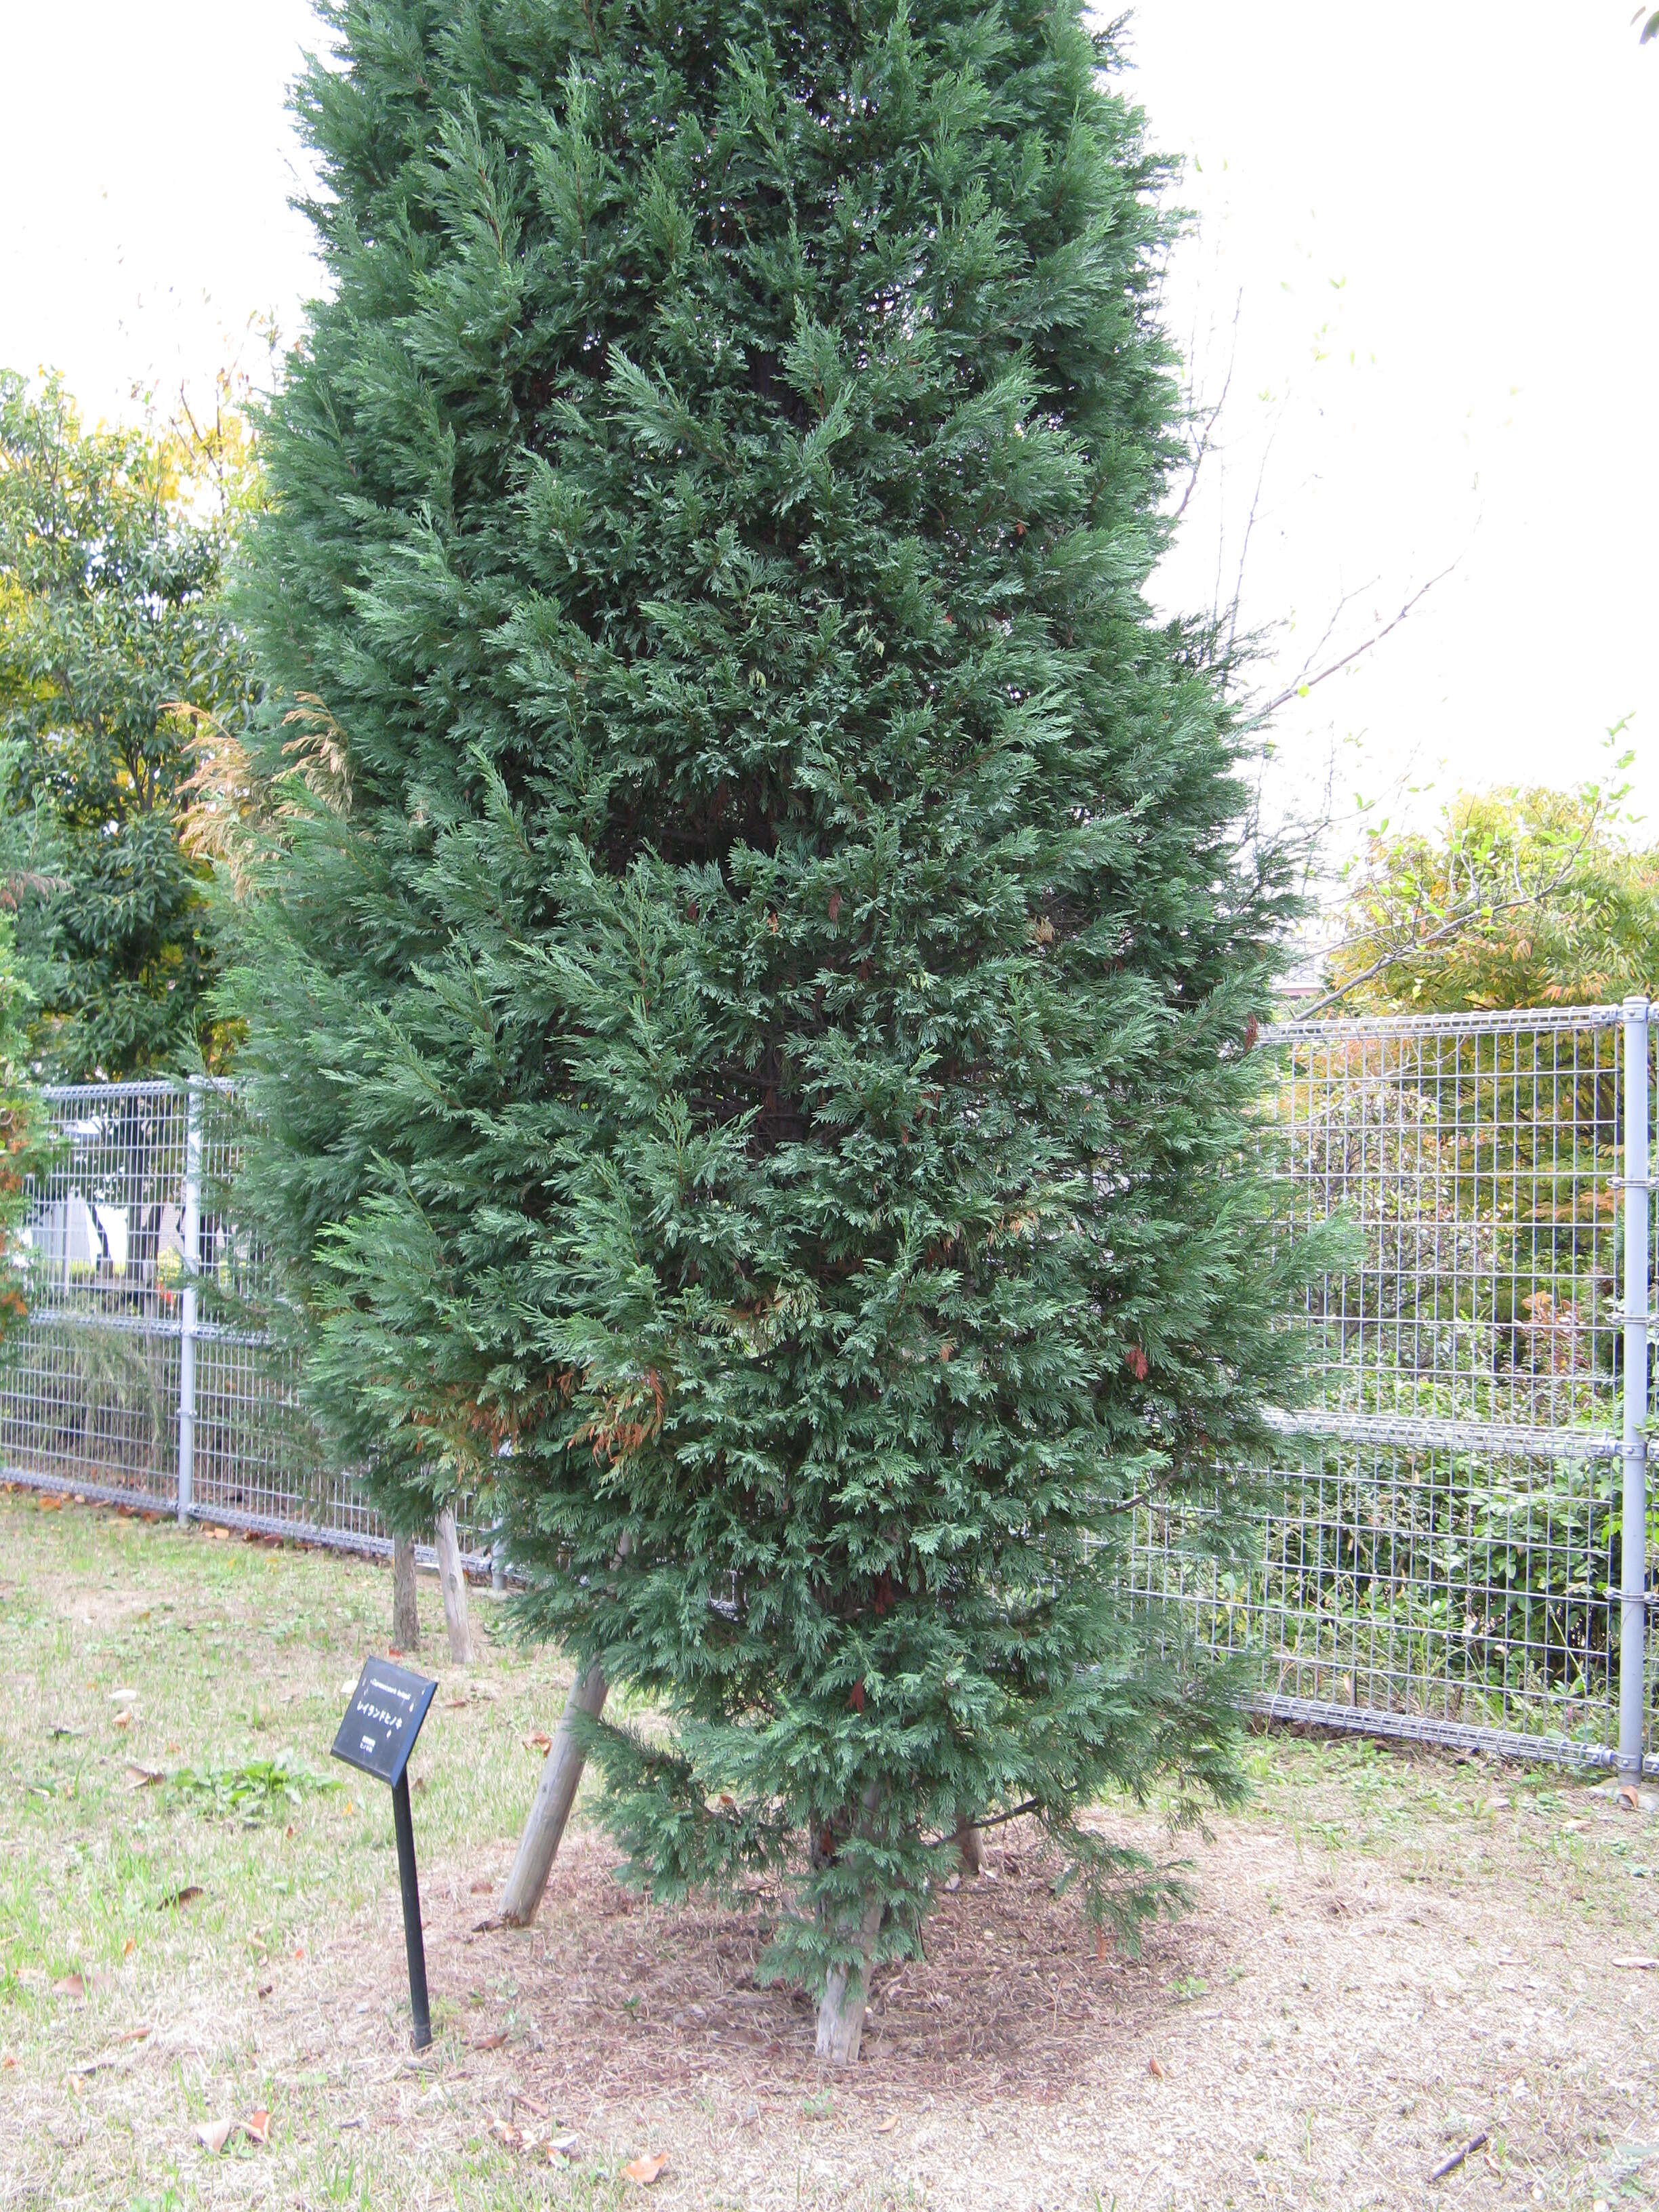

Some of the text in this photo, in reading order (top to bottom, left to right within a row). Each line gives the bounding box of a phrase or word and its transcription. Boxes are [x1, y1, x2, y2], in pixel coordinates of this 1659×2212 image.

[357, 1700, 403, 1729] レイランドヒノキ
